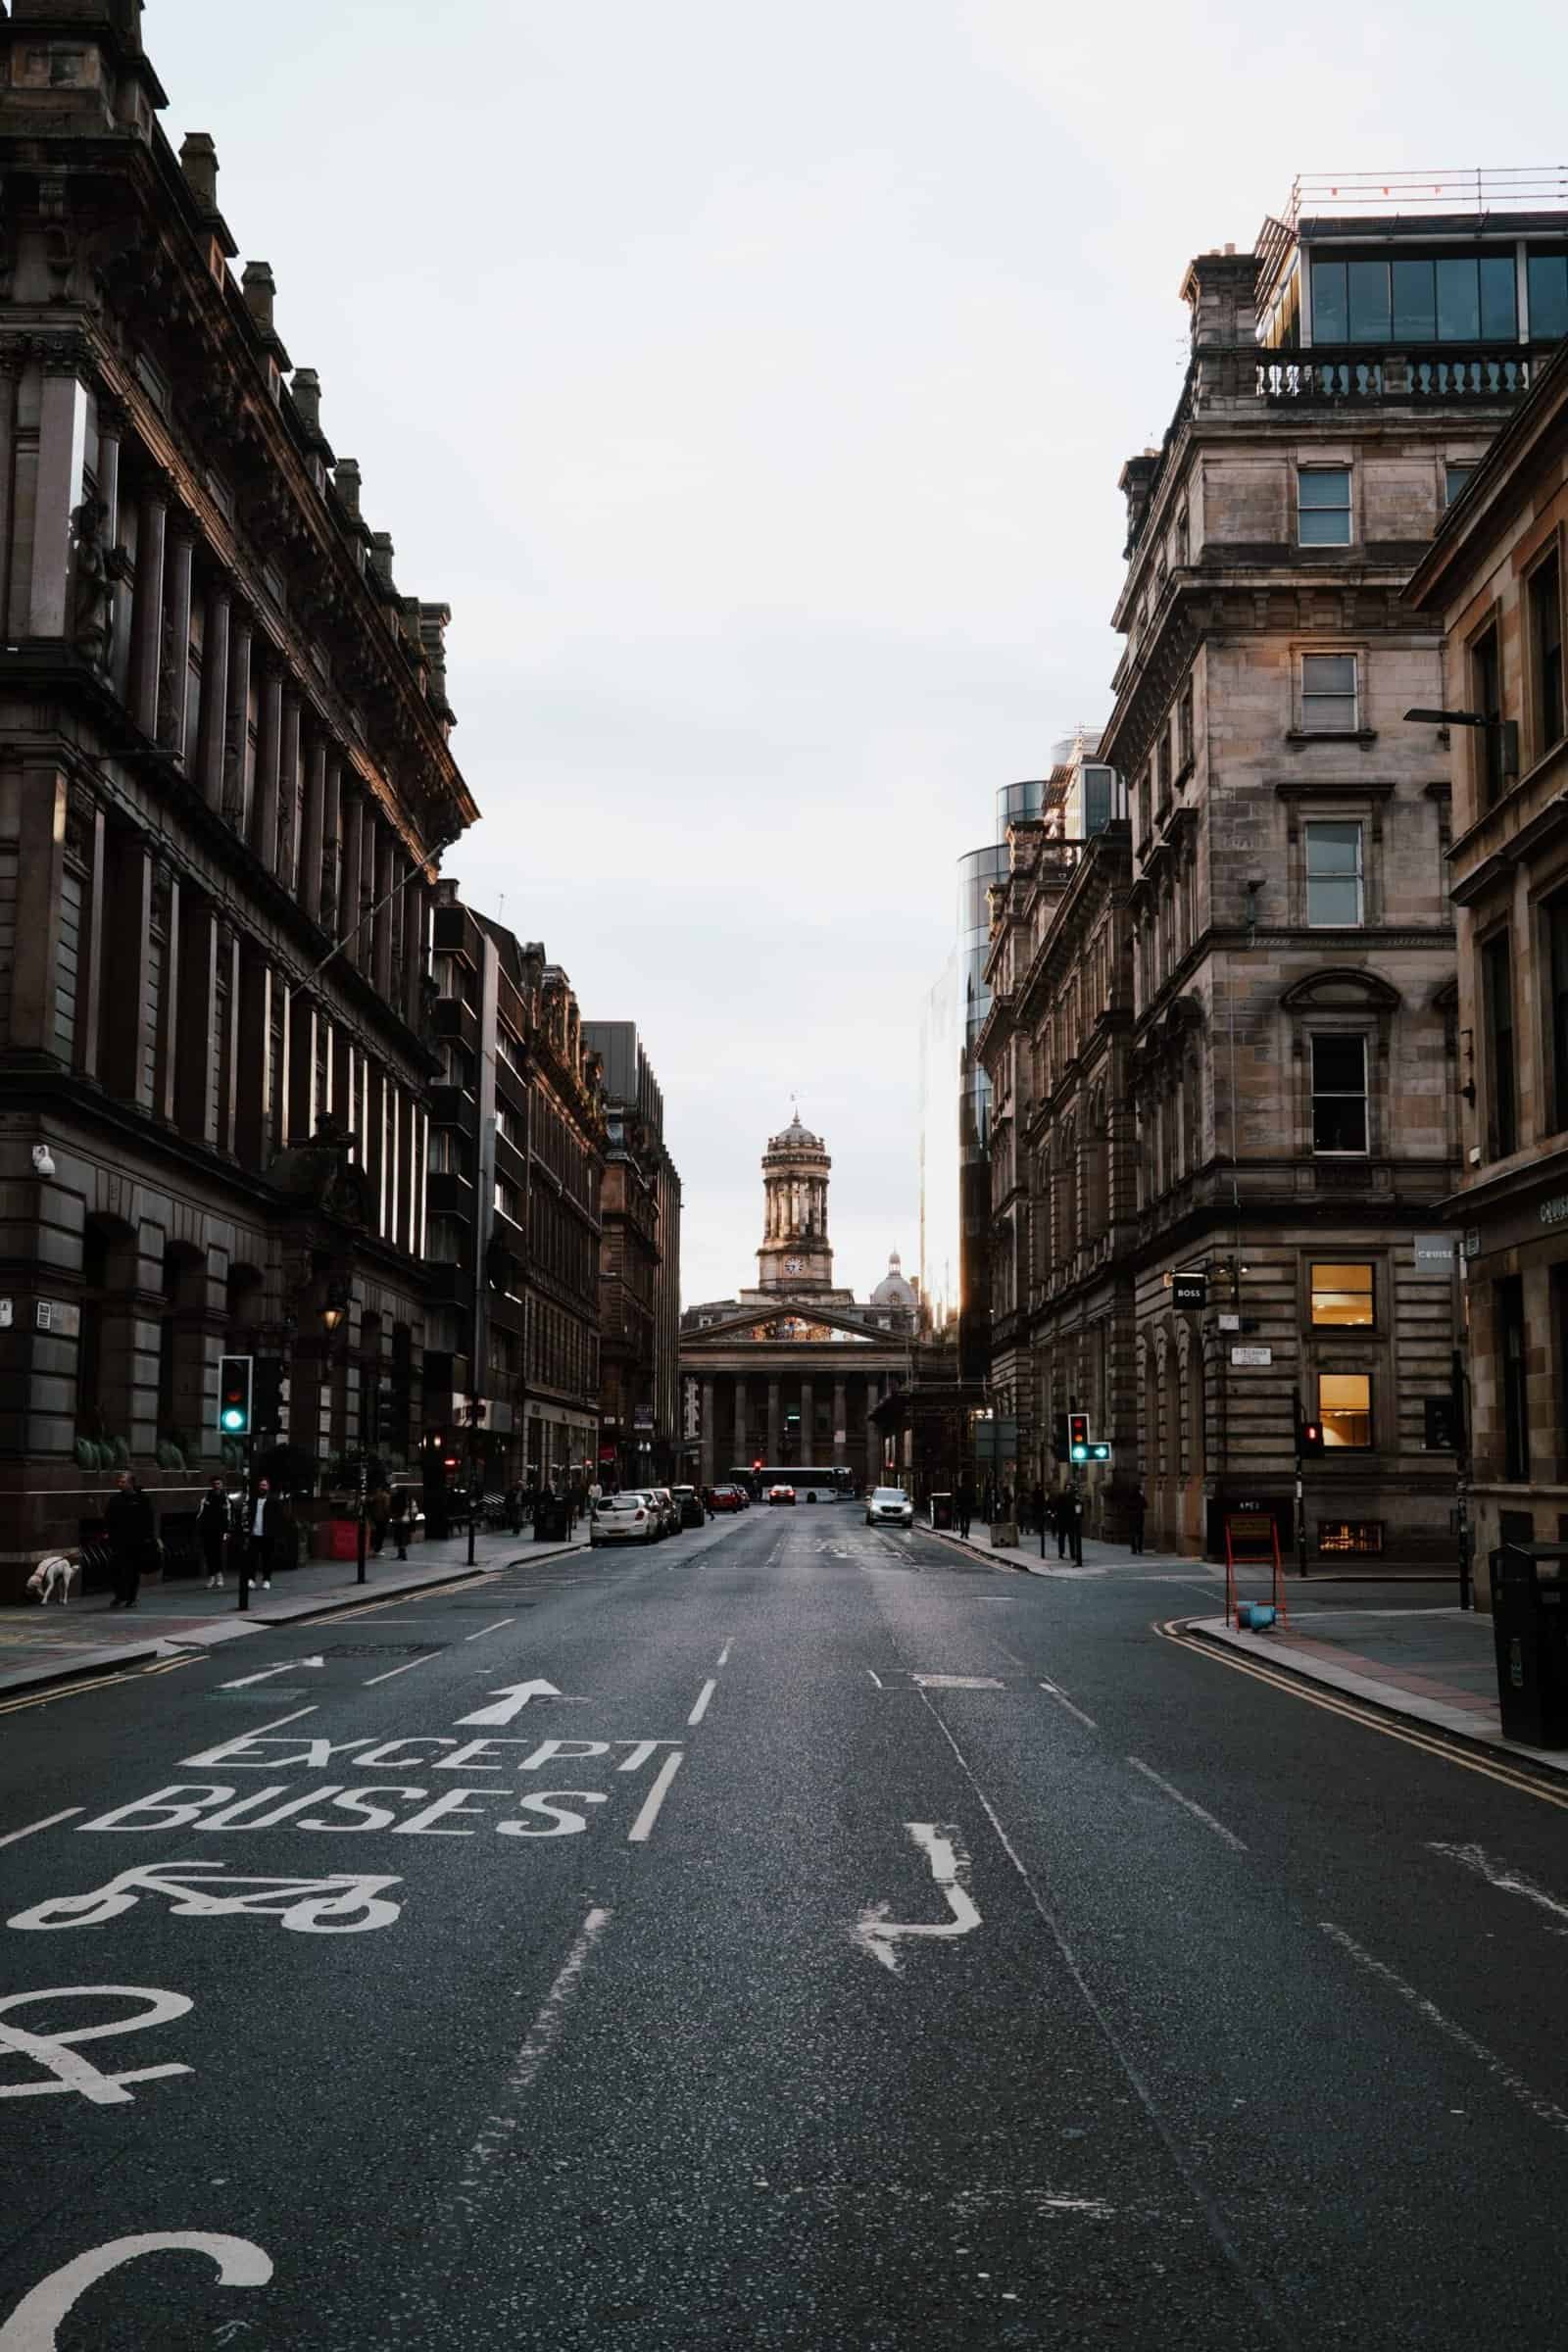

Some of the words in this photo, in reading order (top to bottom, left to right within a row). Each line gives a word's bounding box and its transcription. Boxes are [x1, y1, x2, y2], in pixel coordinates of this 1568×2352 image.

[1178, 1289, 1200, 1298] BOSS
[179, 1739, 683, 1771] EXCEPT
[74, 1785, 610, 1838] BUSES
